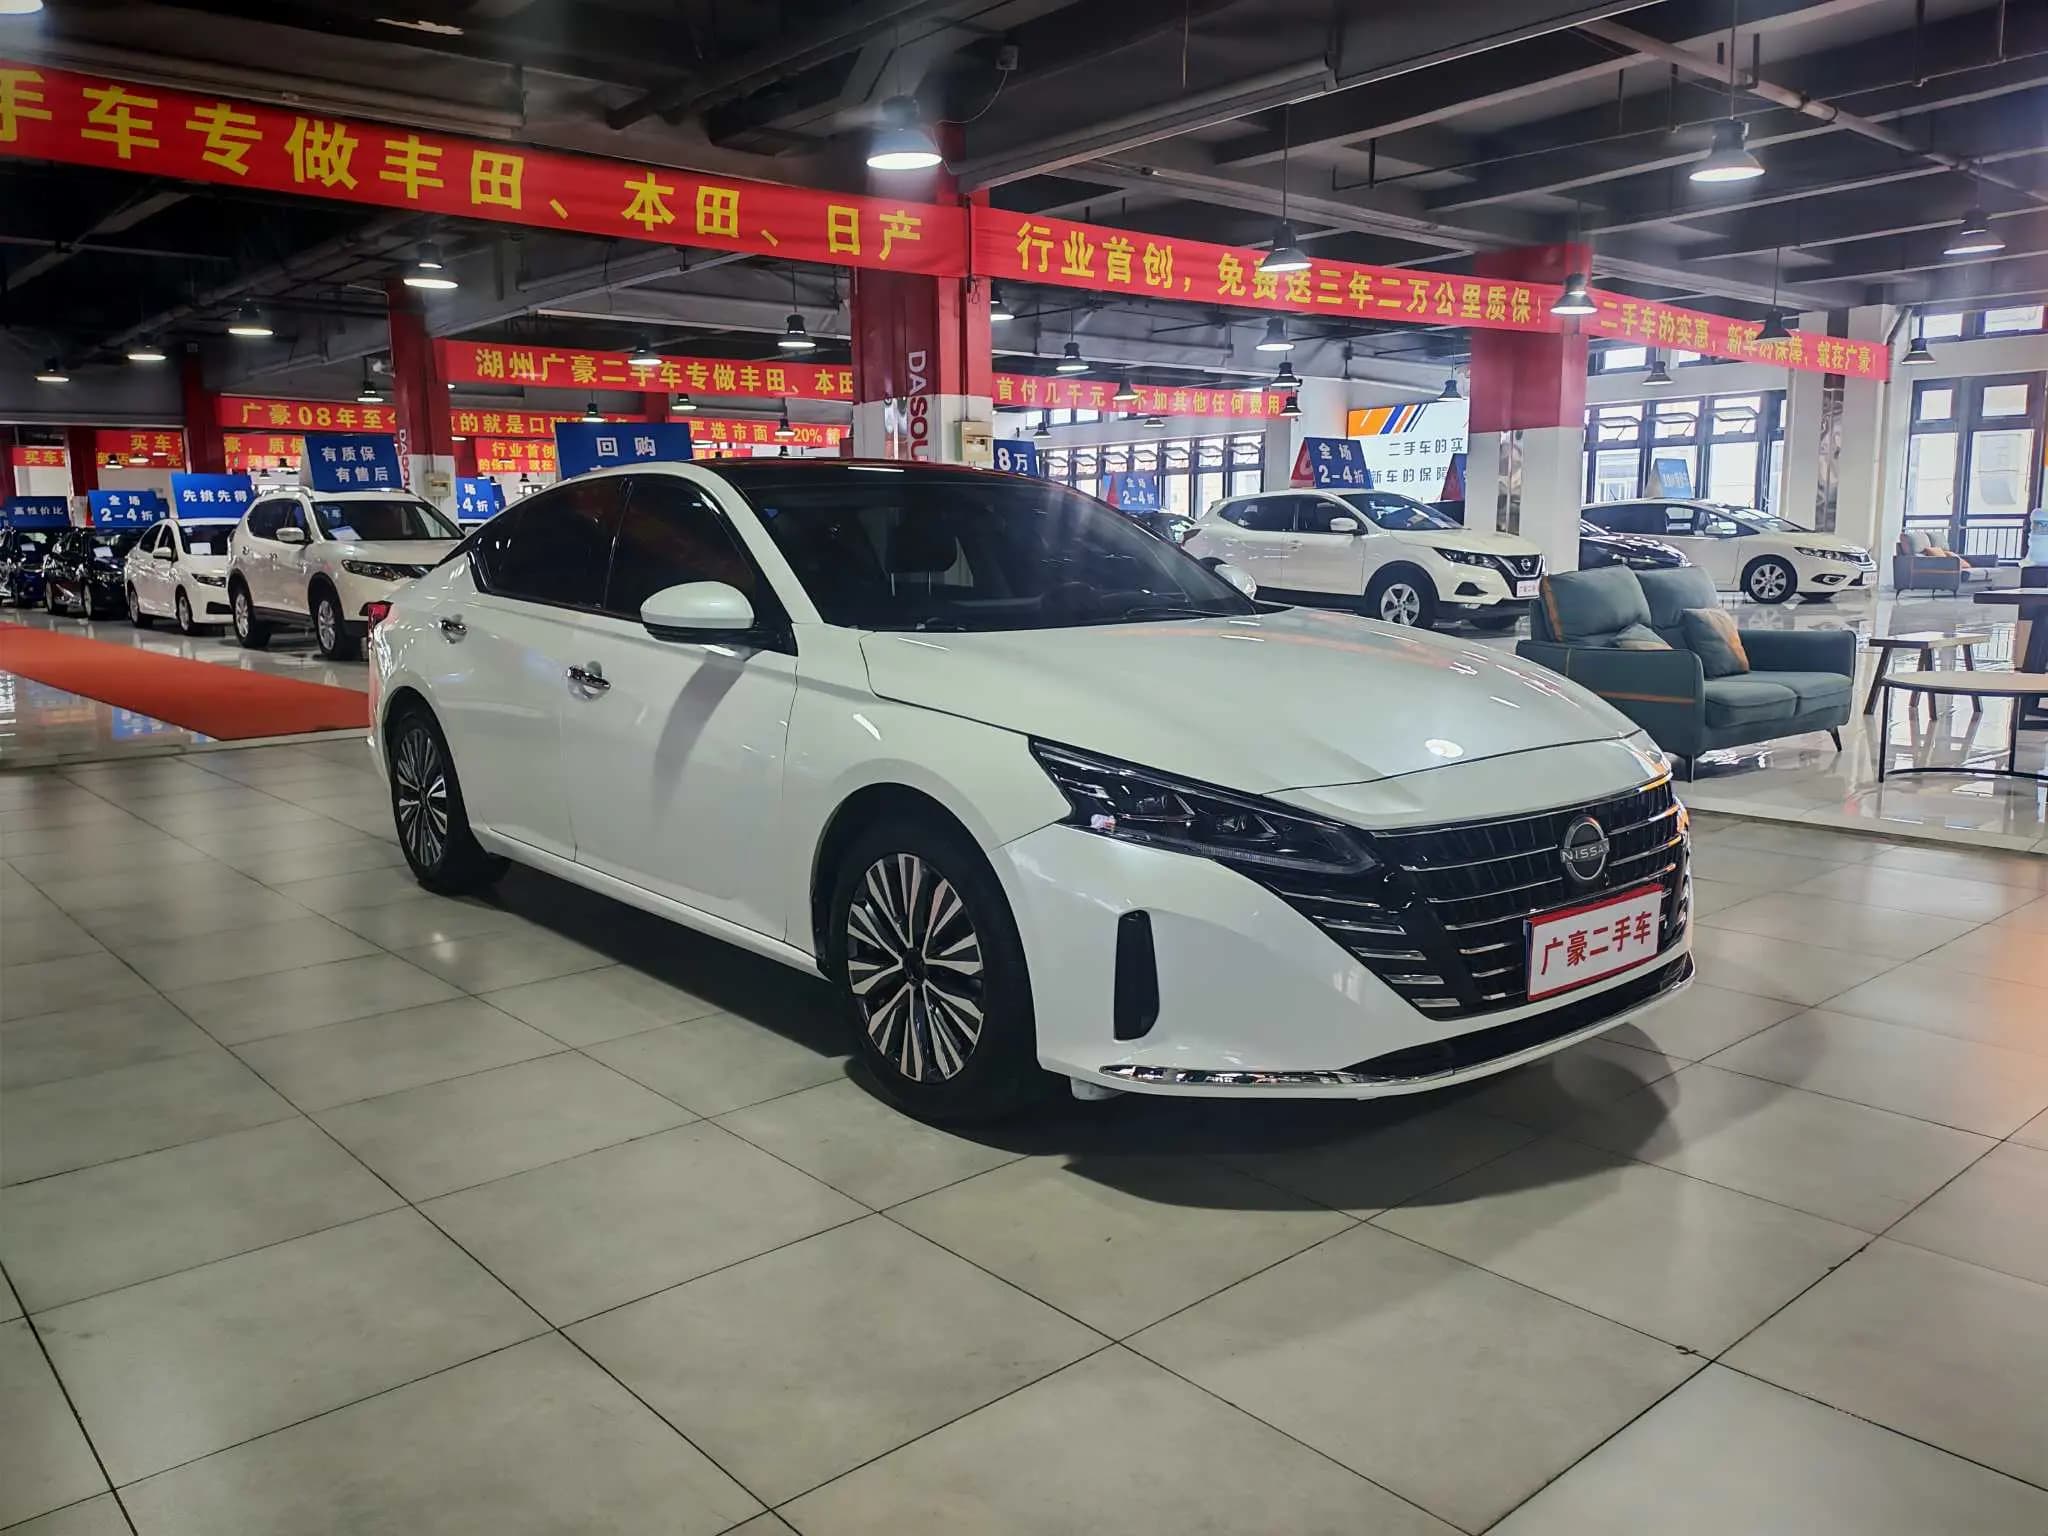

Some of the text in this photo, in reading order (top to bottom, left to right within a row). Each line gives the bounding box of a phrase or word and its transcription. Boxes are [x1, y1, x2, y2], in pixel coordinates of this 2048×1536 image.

[130, 433, 182, 451] 买车
[596, 437, 656, 457] 回购
[24, 450, 64, 464] 买车
[321, 446, 376, 462] 有质保
[997, 447, 1028, 471] 8万
[1318, 442, 1352, 461] 全场
[335, 466, 389, 483] 有售后
[1541, 910, 1652, 976] 广豪二手车
